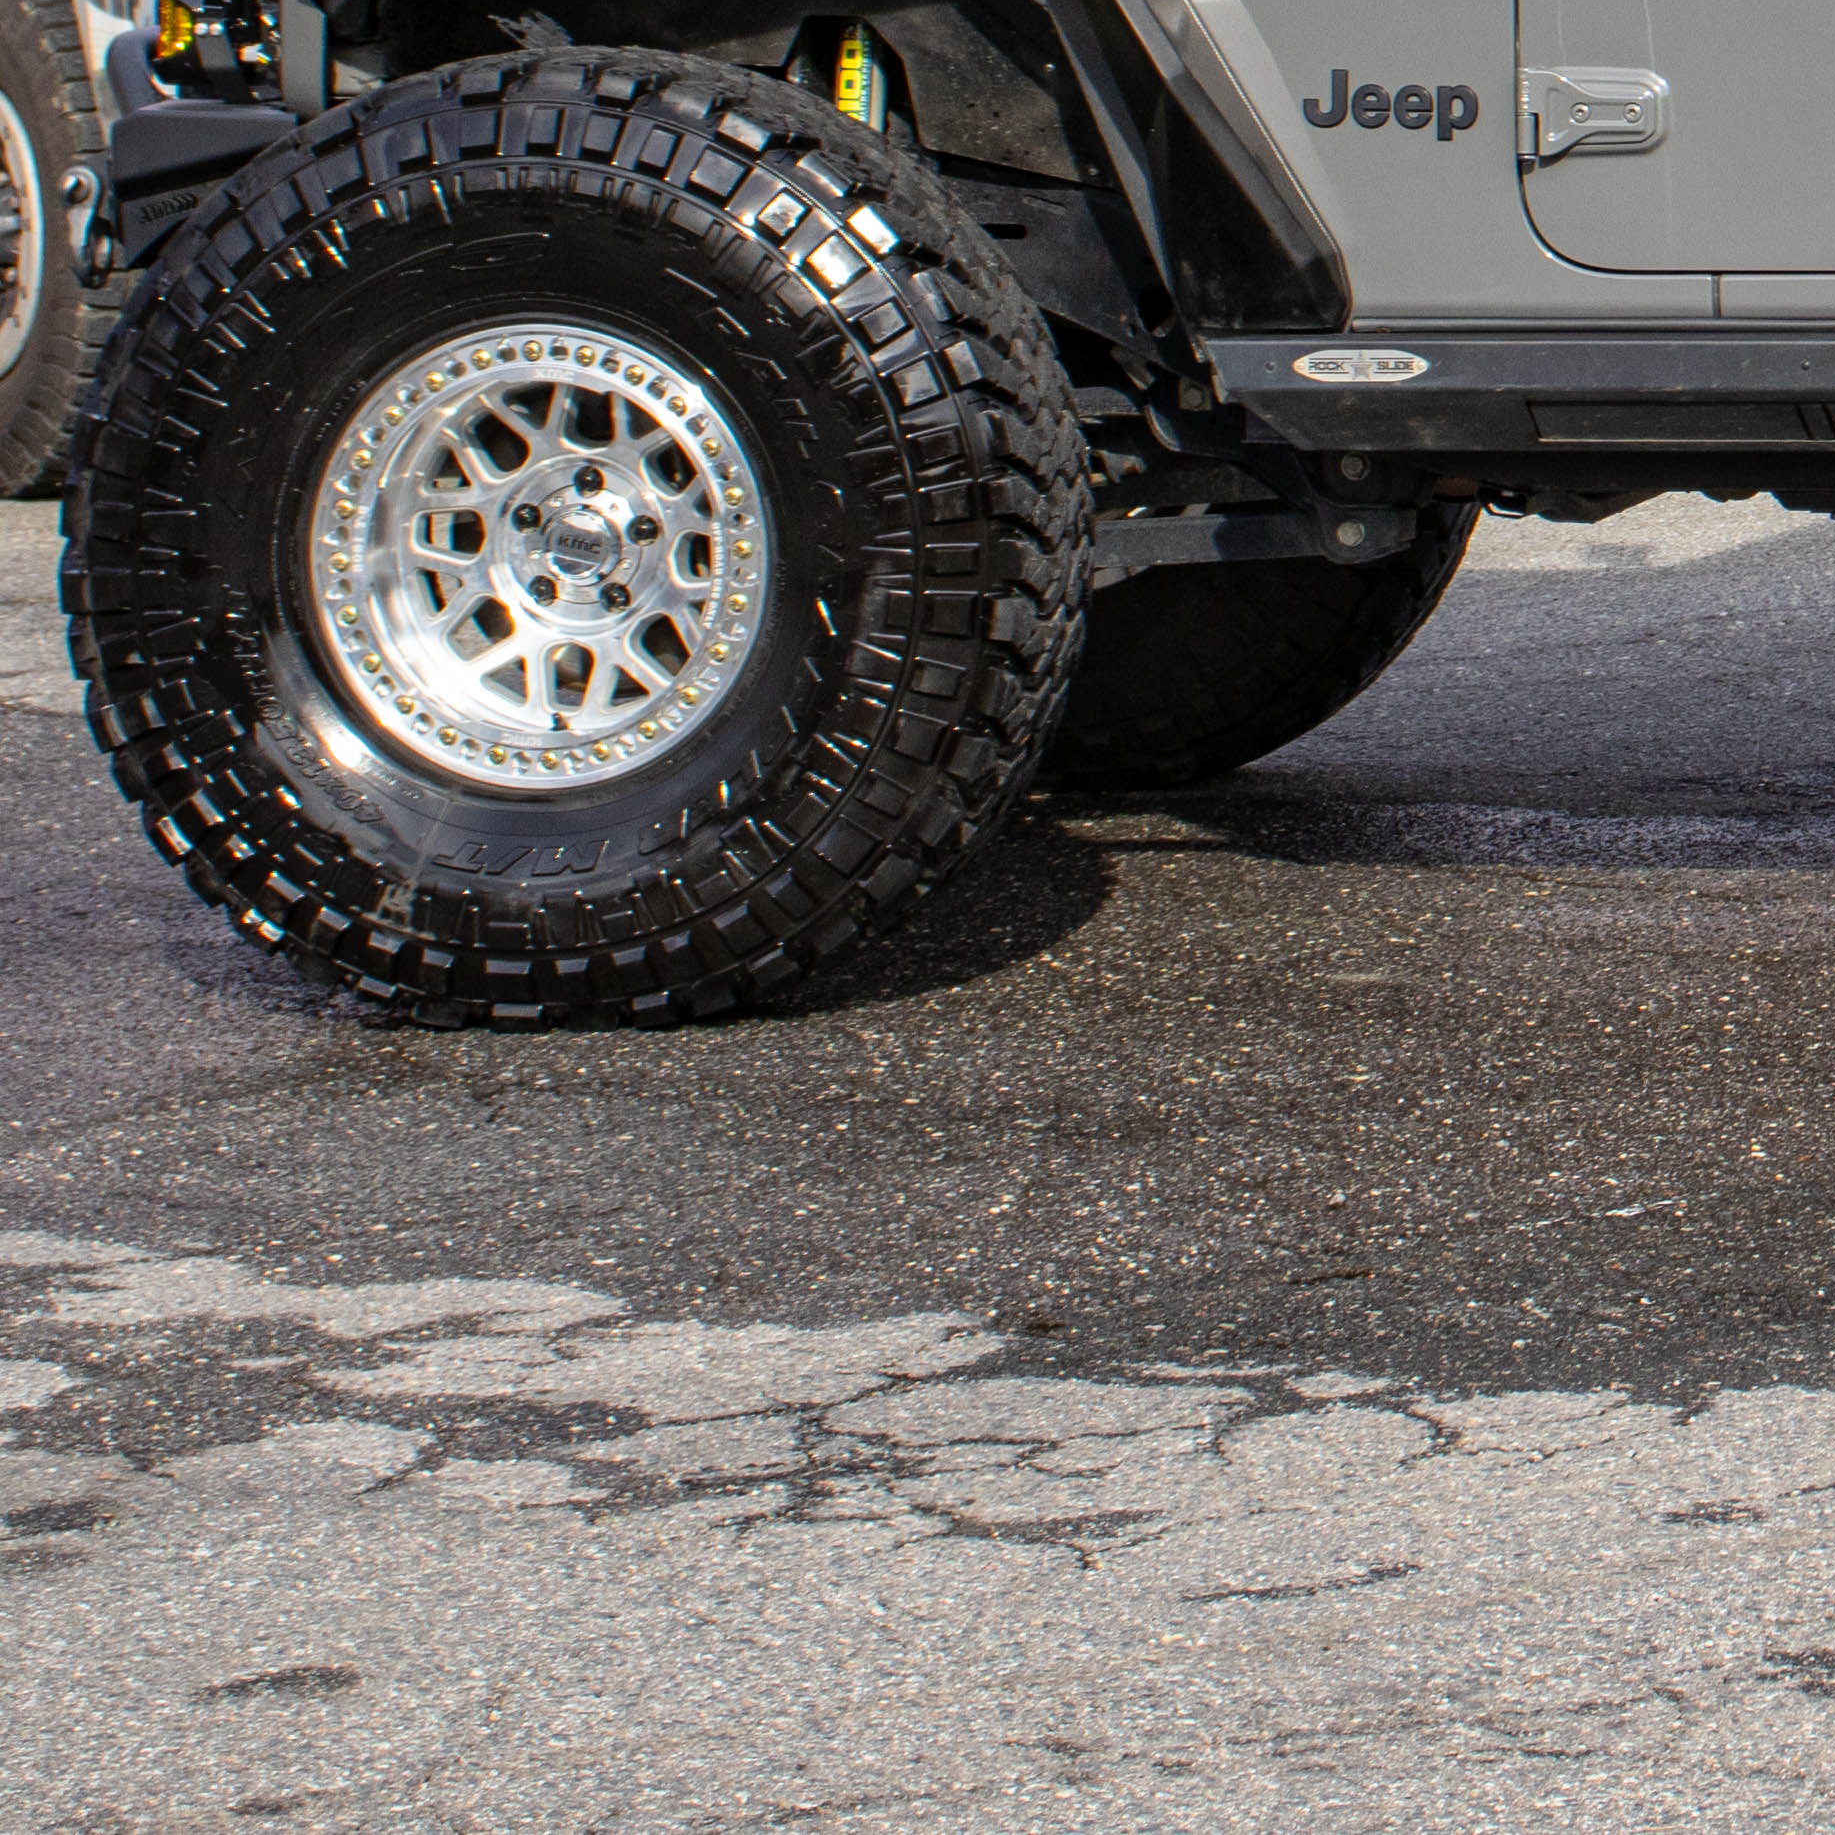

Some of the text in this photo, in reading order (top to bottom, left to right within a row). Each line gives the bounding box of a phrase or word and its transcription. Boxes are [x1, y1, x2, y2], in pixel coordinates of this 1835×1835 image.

[1302, 69, 1480, 142] Jeep
[1308, 361, 1415, 371] ROCK SLIDE
